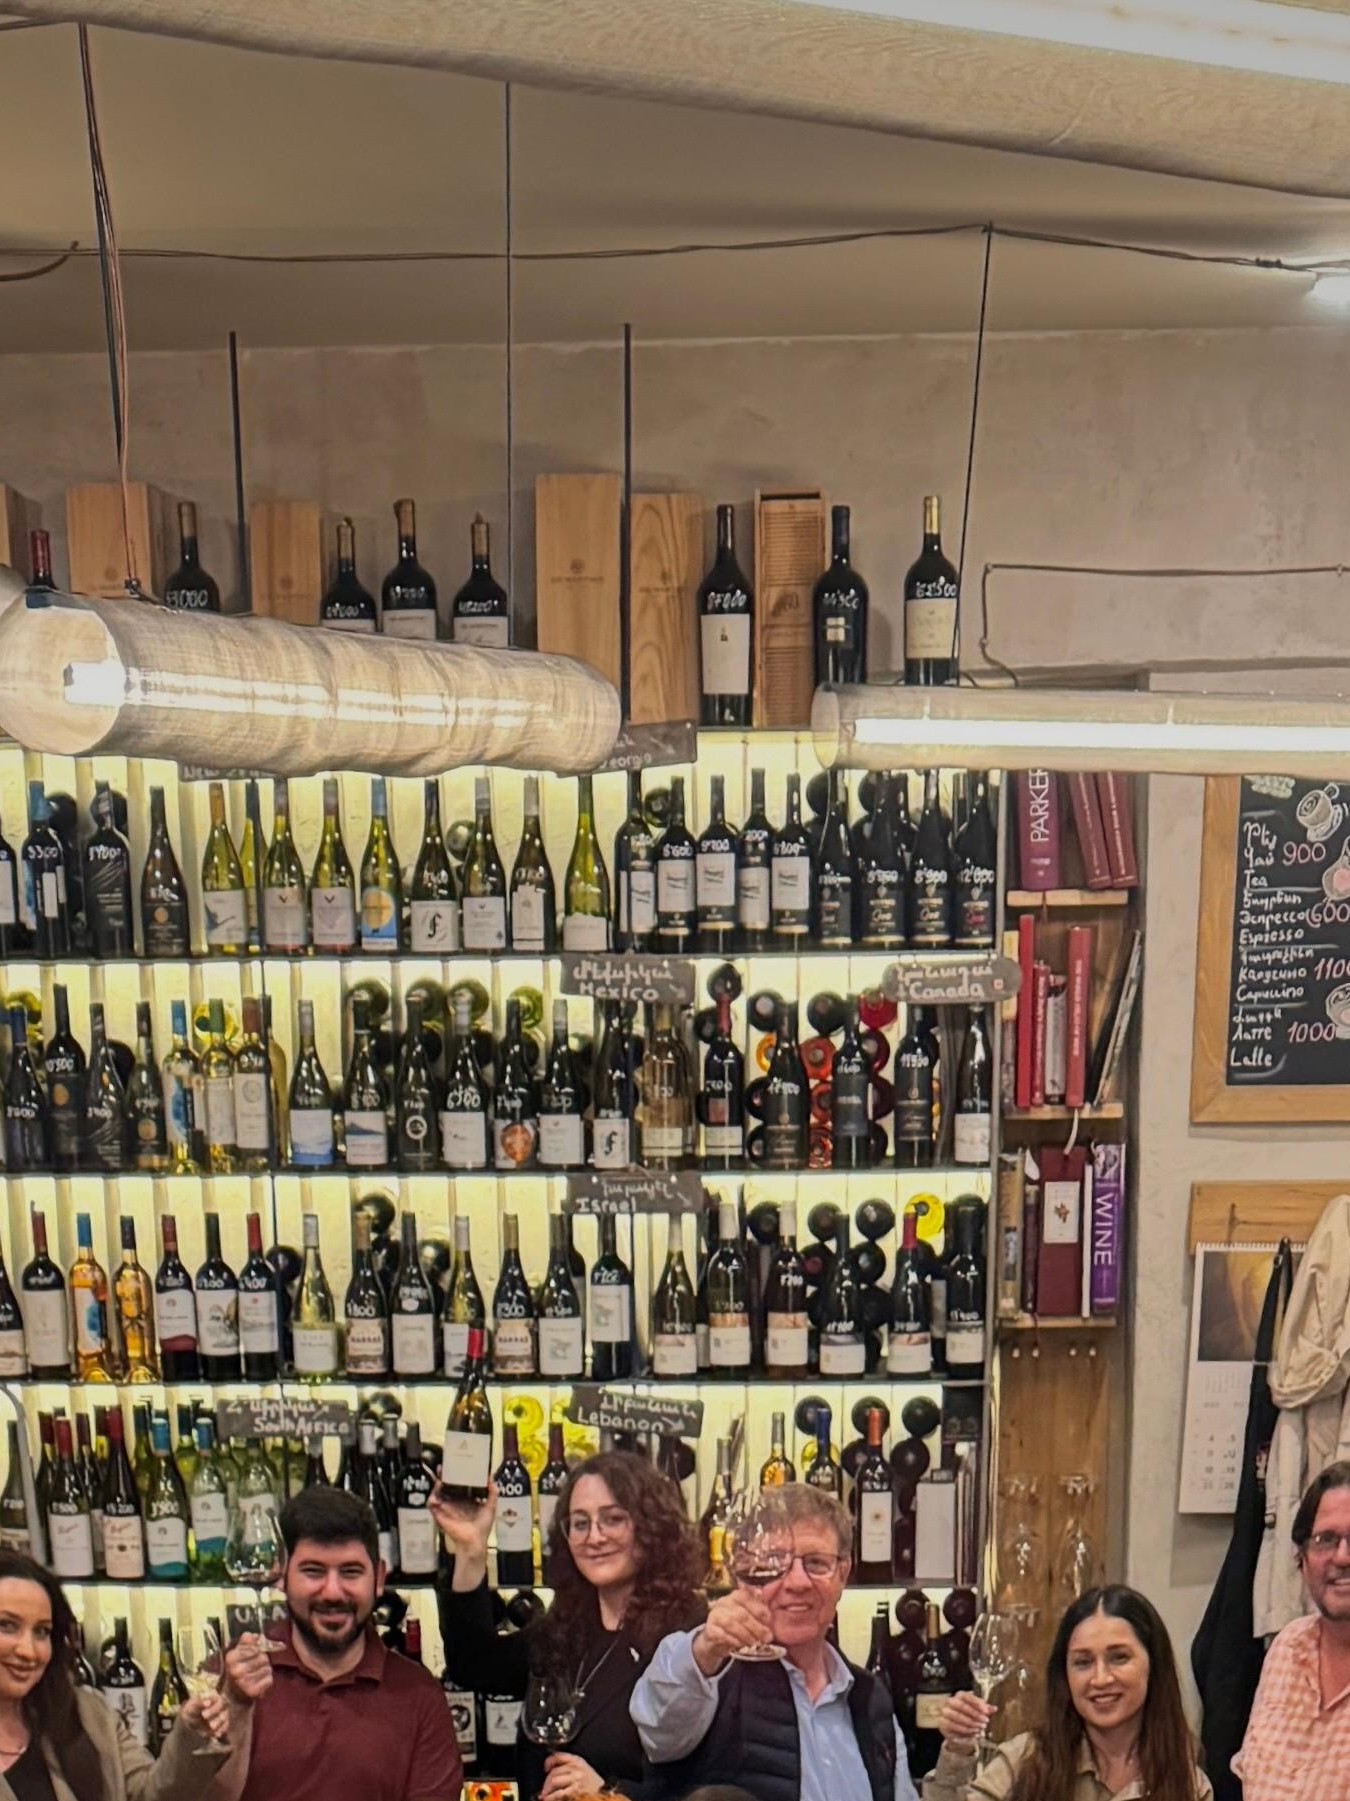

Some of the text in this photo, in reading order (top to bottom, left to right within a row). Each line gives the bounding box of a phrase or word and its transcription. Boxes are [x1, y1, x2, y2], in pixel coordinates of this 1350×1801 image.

[1282, 841, 1326, 866] 900
[1244, 868, 1268, 888] Tea
[1240, 928, 1304, 946] Espresso
[580, 982, 659, 1001] Mexico
[909, 984, 985, 999] Canada
[1287, 1022, 1337, 1043] 1000
[576, 1197, 637, 1213] Israel
[1094, 1192, 1114, 1266] WINE
[578, 1410, 665, 1433] Lebanon
